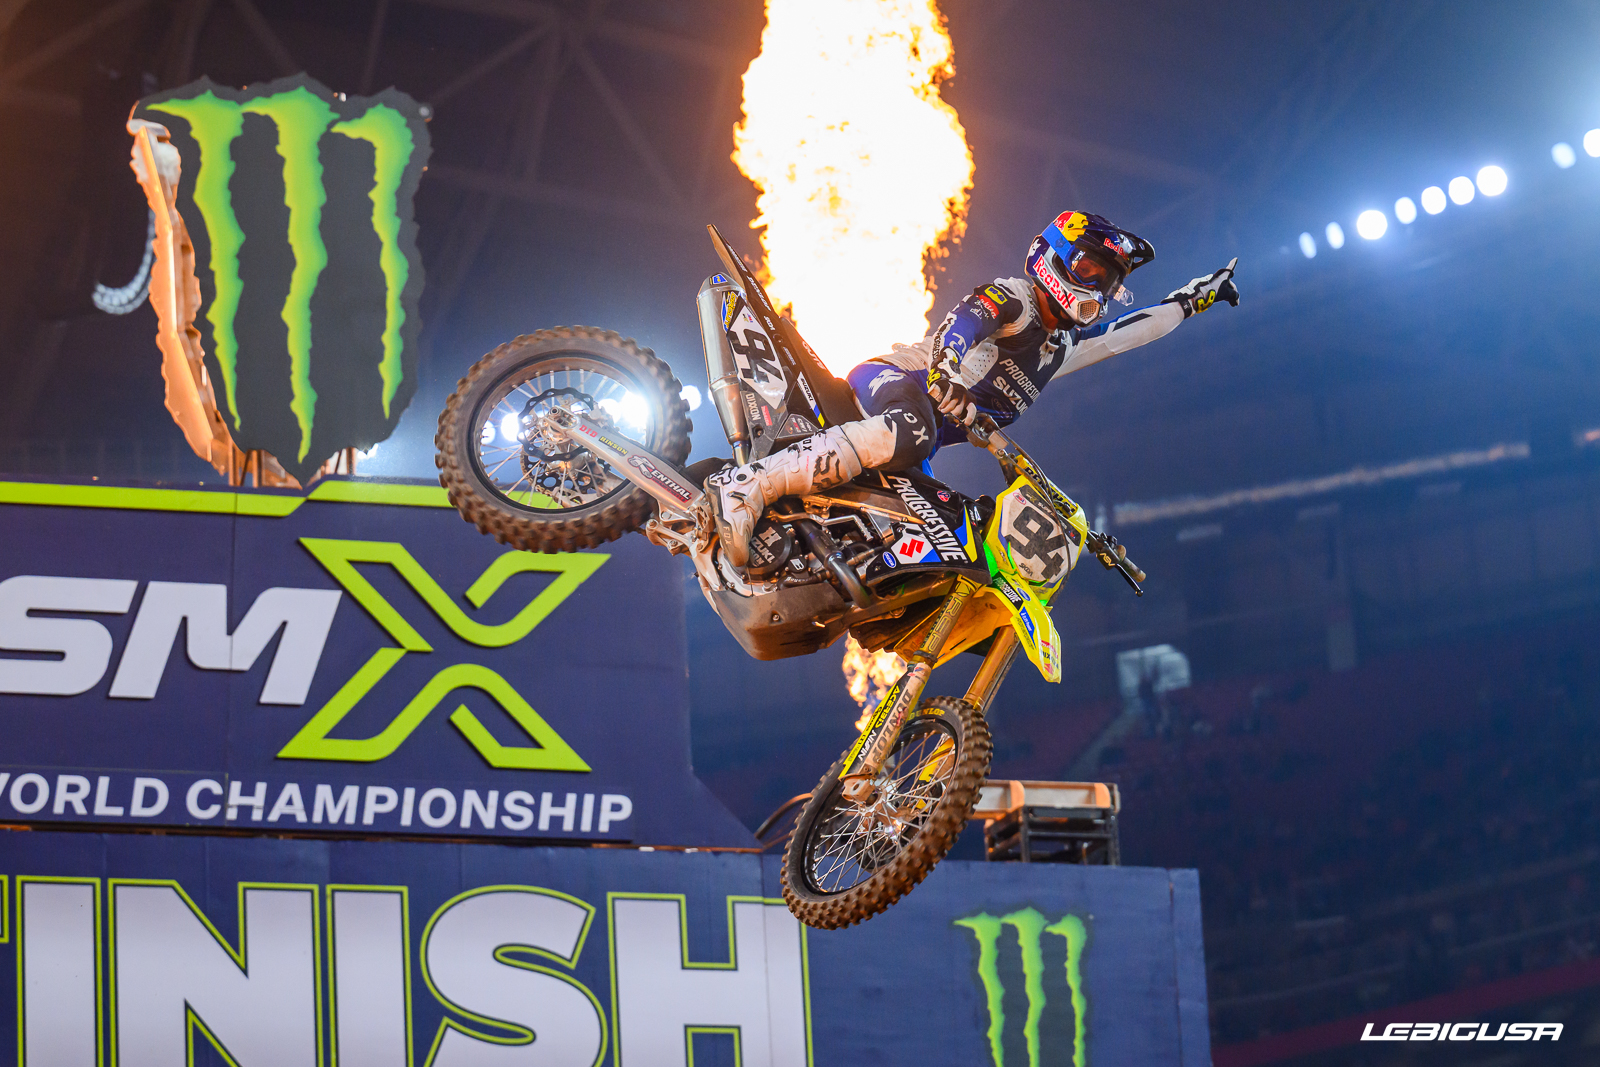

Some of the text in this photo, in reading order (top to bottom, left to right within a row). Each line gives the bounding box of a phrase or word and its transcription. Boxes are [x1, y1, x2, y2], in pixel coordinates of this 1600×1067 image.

[727, 329, 784, 383] 94
[745, 392, 761, 421] DIXXON
[800, 377, 814, 402] SUZUKI
[579, 424, 598, 438] DID
[599, 436, 628, 455] HINSON
[803, 438, 812, 451] OX
[627, 454, 692, 500] RENTHAL
[723, 526, 732, 546] FOX
[887, 475, 967, 562] PROGRESSIVE
[1004, 505, 1069, 582] 94
[0, 771, 634, 833] ORLD CHAMPIONSHIP
[0, 874, 814, 1067] INISH
